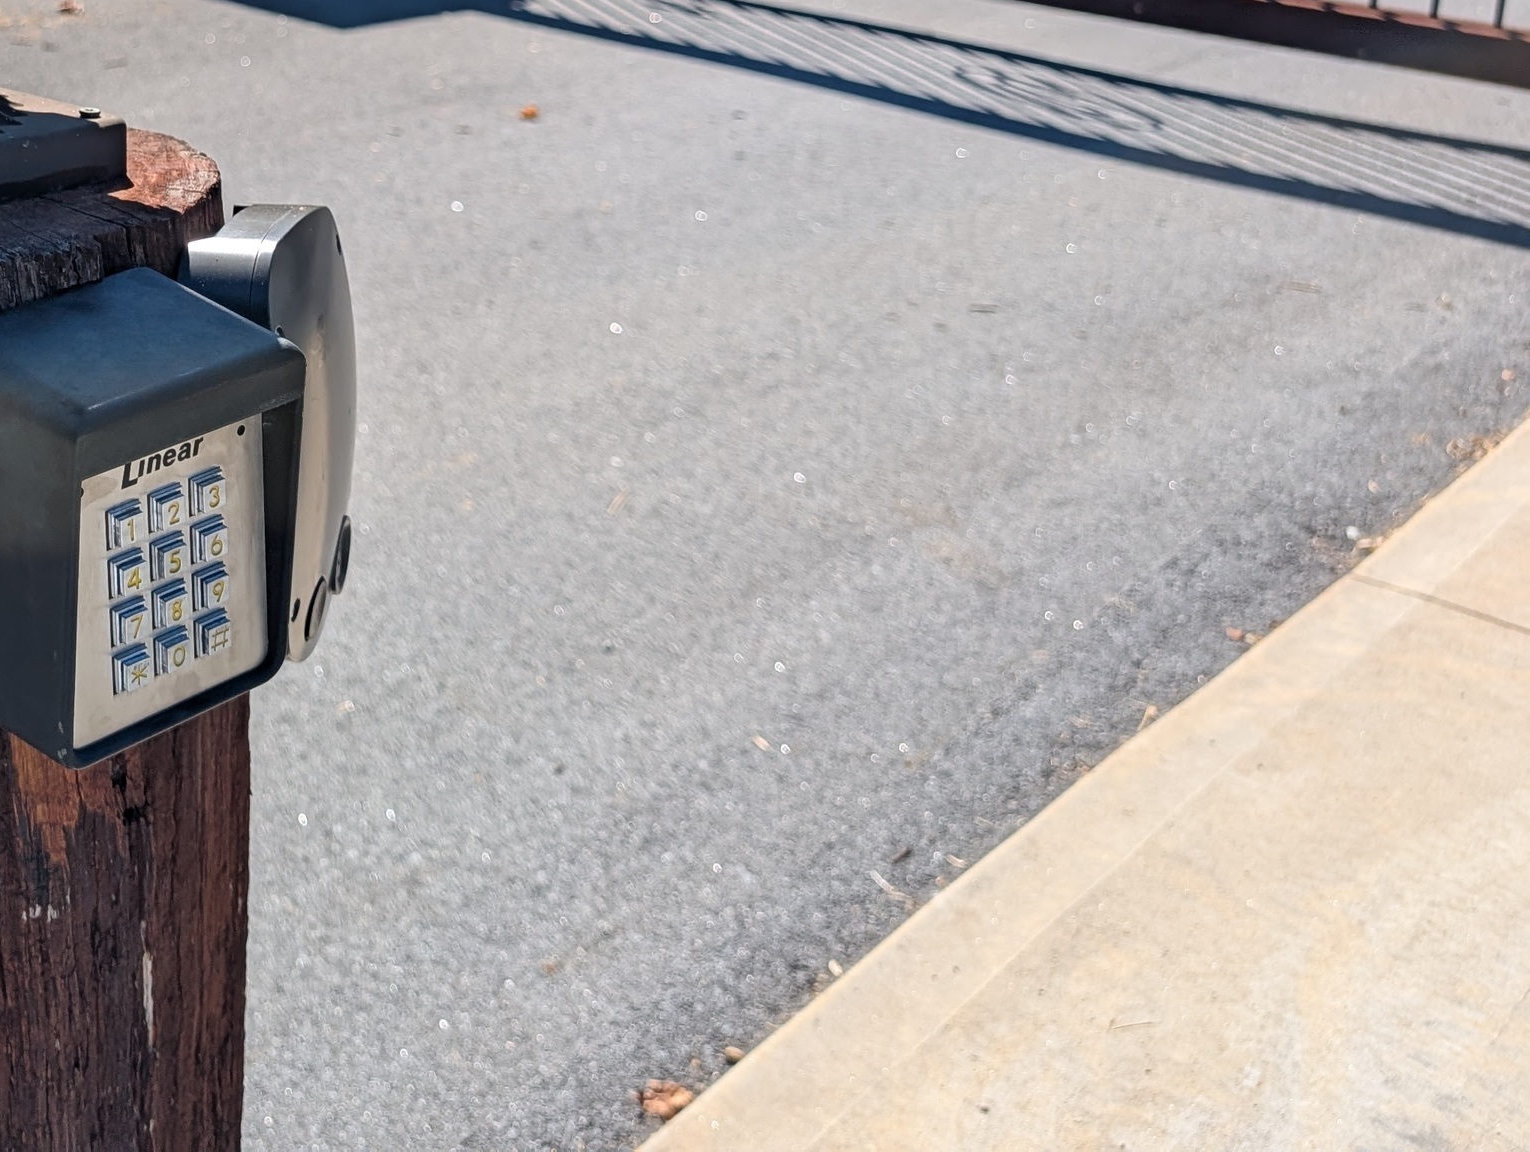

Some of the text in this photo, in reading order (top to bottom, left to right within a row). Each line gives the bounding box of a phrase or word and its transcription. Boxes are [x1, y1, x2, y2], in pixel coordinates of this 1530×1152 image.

[121, 436, 204, 490] Linear
[127, 485, 220, 542] 1 2 3
[128, 533, 223, 590] 4 5 6
[130, 580, 225, 639] 7 8 9
[173, 645, 186, 667] 0
[211, 625, 230, 651] #
